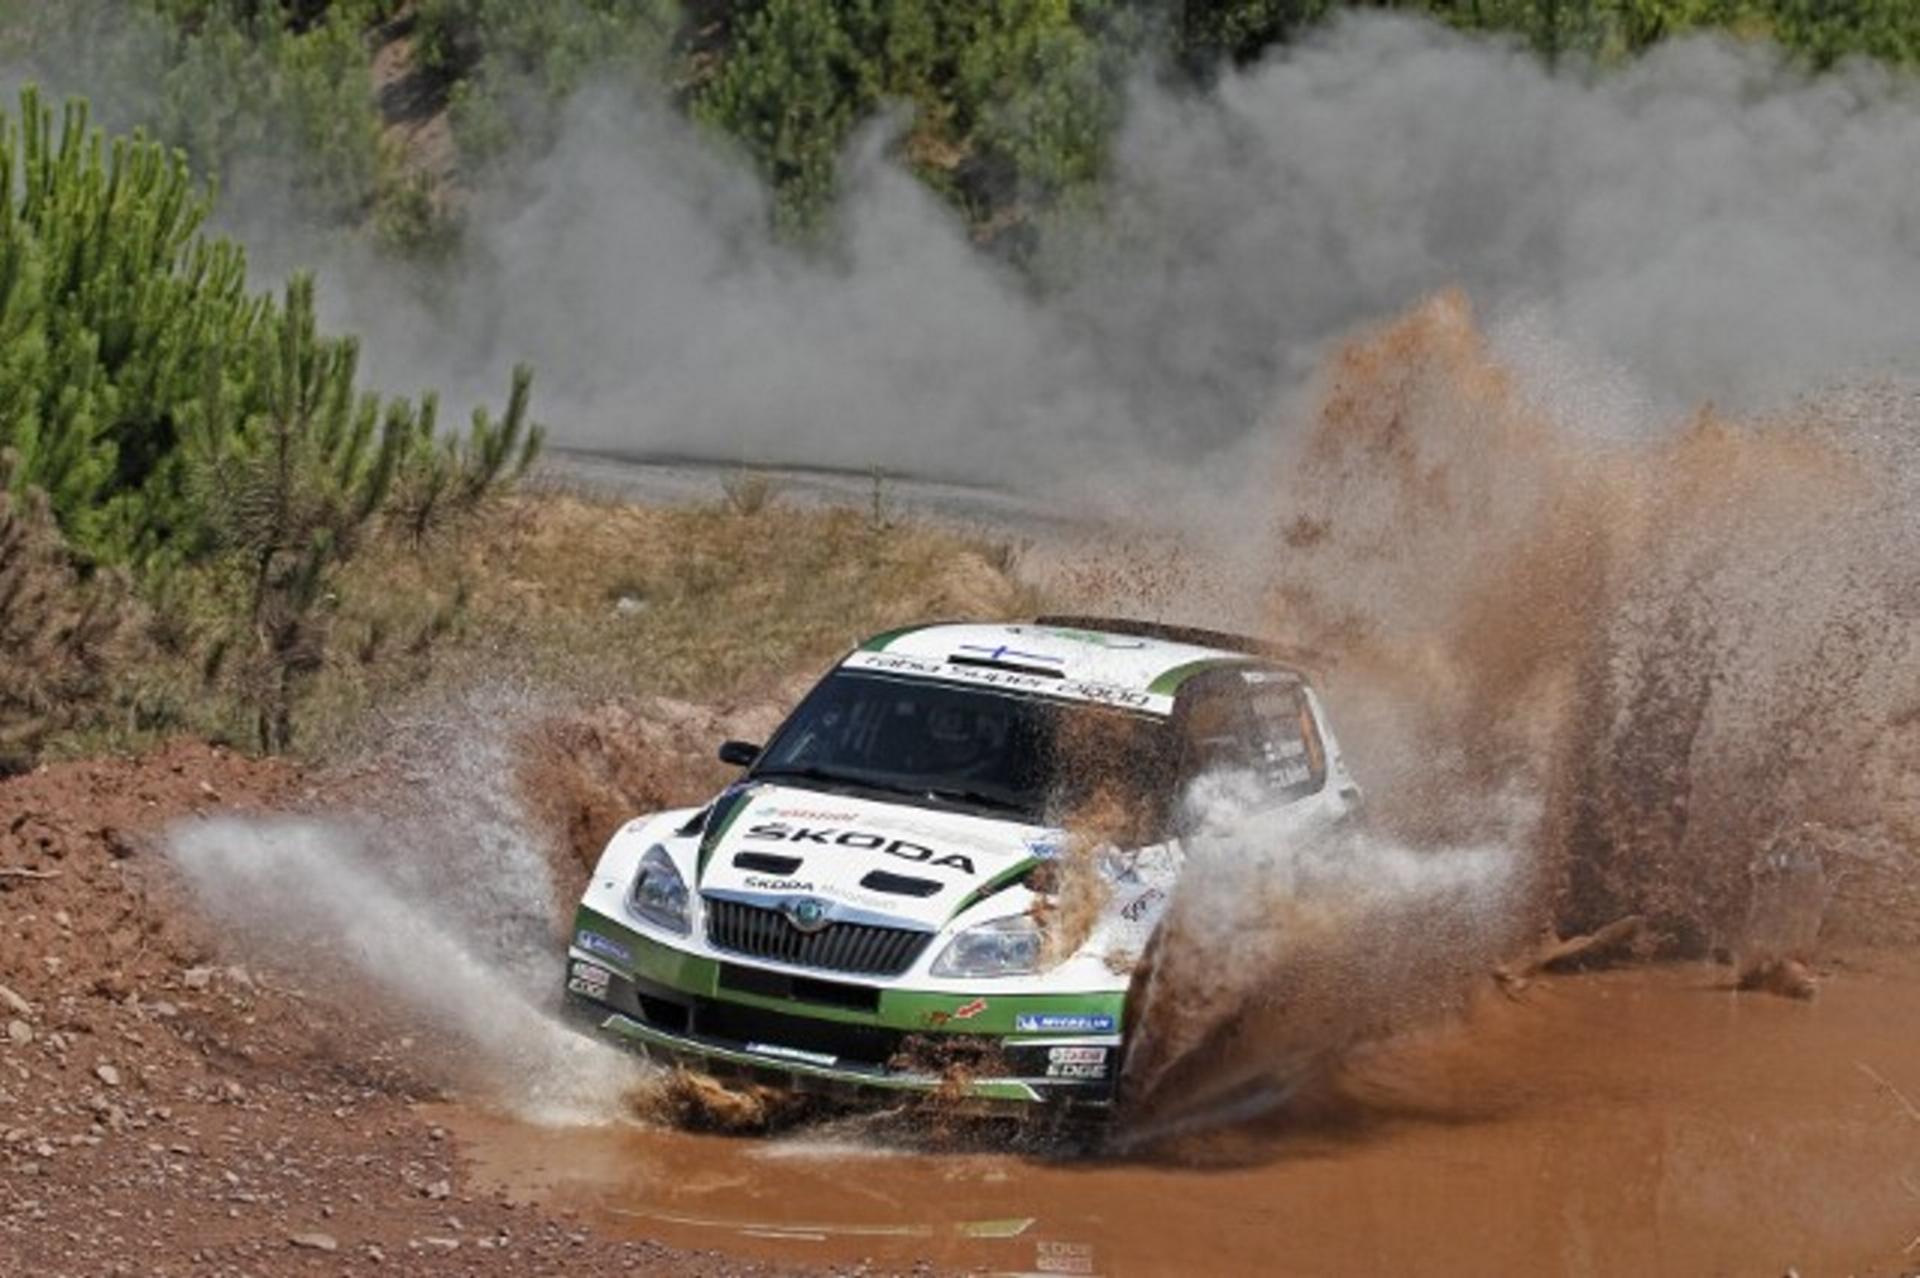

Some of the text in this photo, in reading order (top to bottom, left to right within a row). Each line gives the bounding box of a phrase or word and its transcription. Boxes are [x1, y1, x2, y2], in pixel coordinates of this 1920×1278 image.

[743, 822, 976, 875] ŠKODA
[1042, 1016, 1111, 1029] MICHELIN
[1045, 1063, 1108, 1079] EDGE
